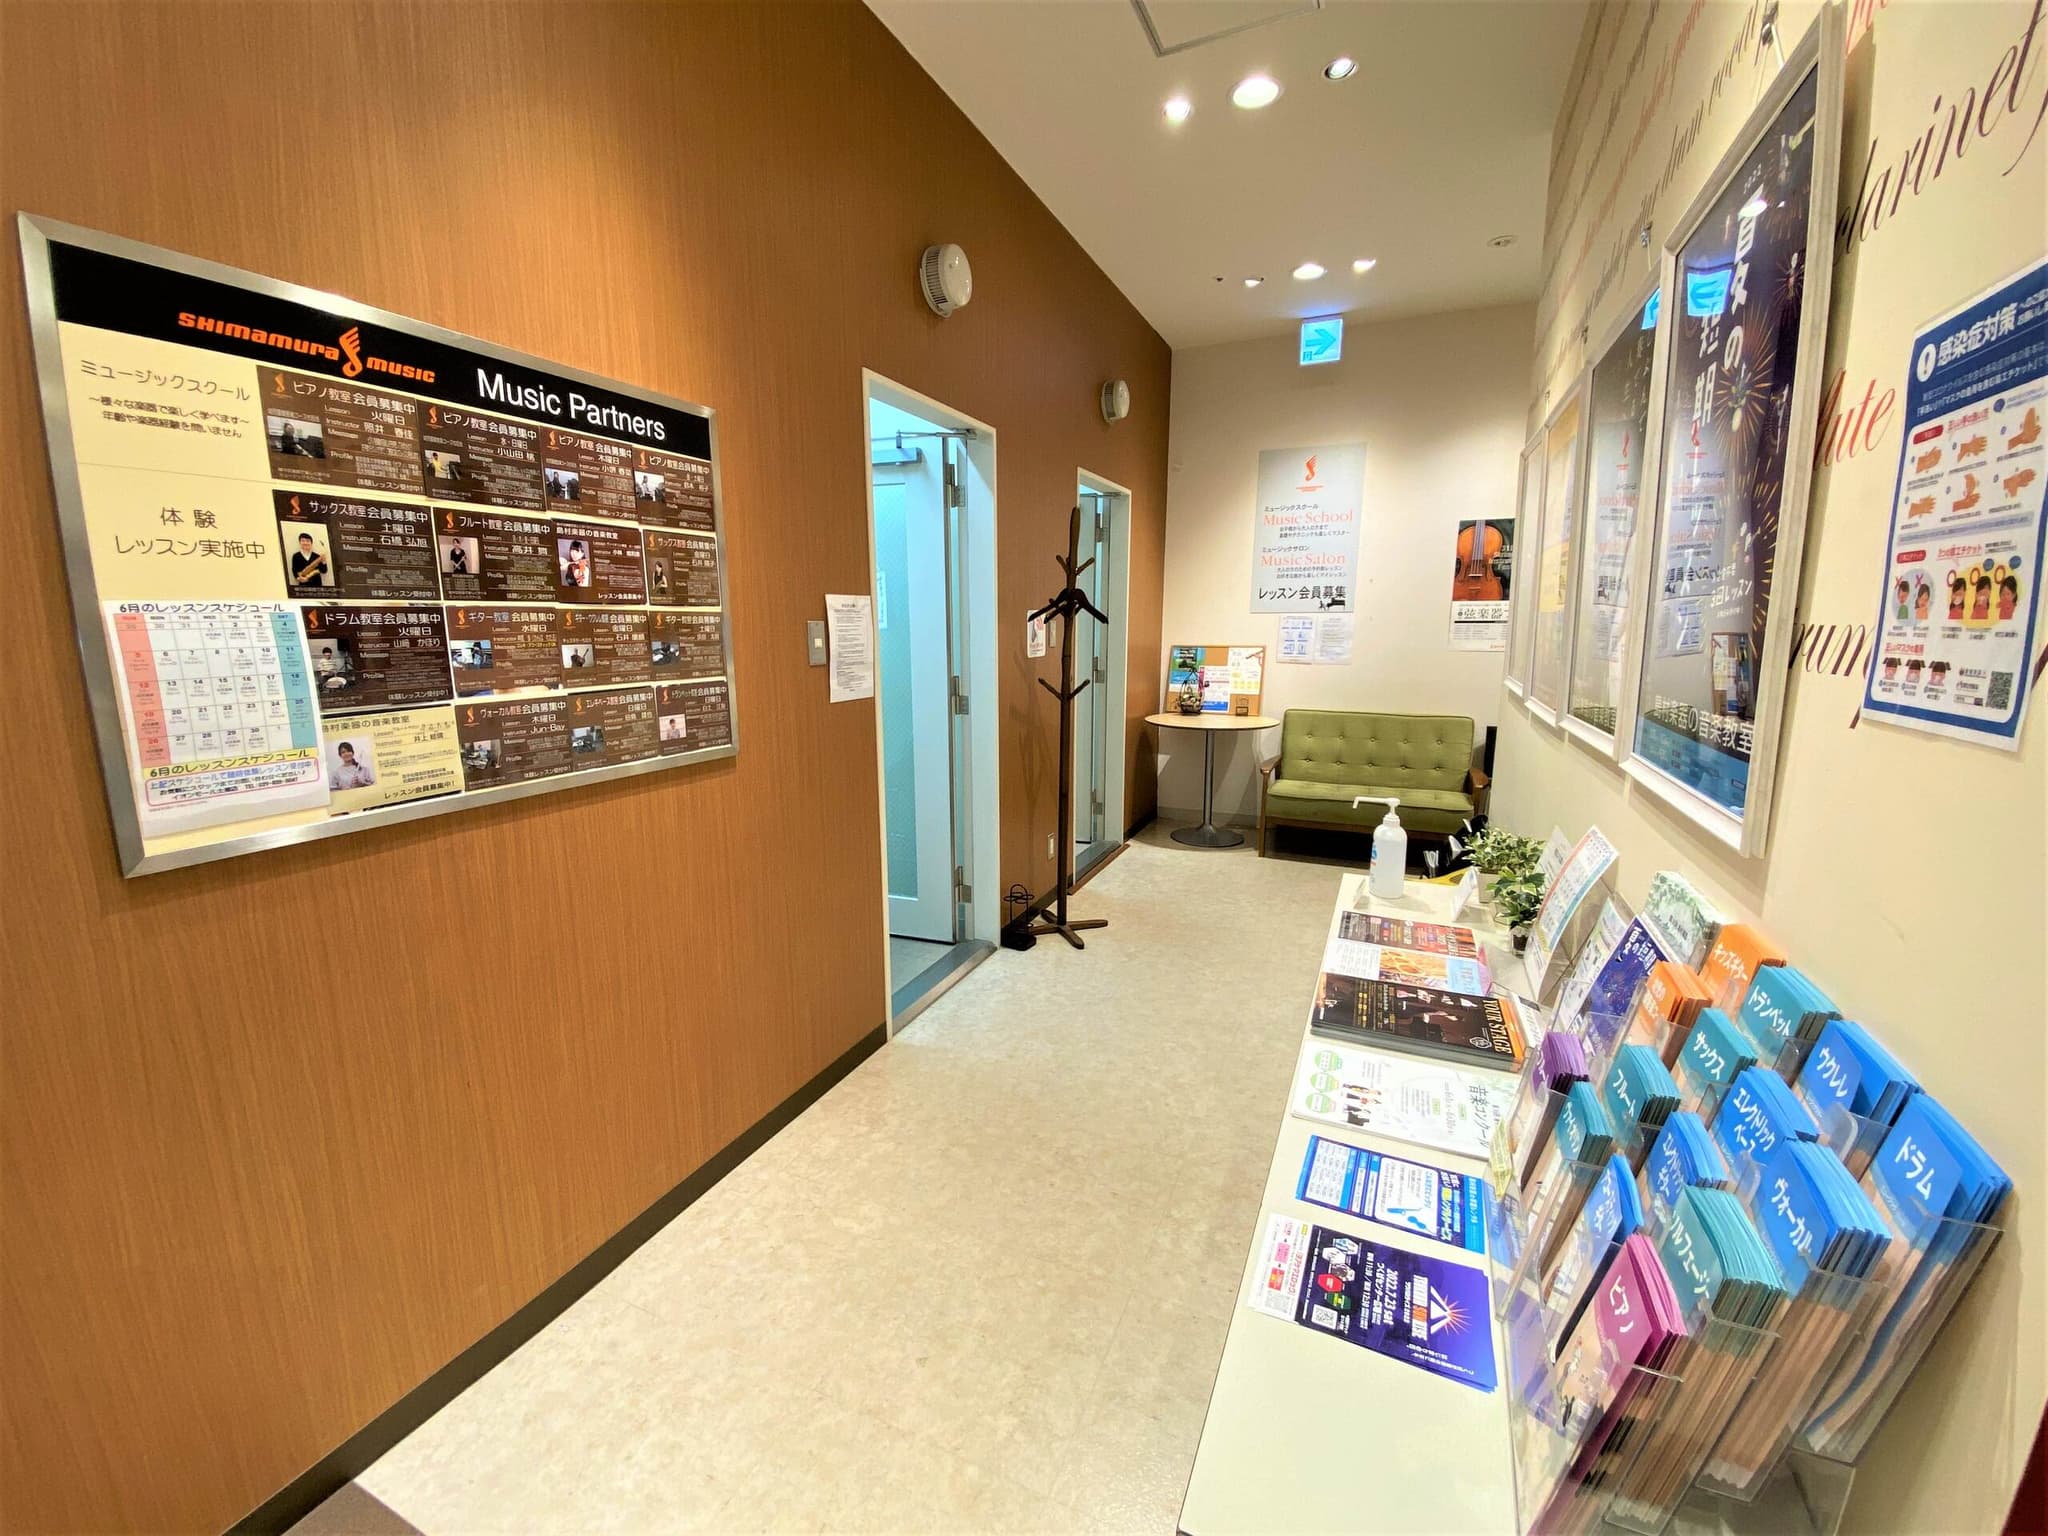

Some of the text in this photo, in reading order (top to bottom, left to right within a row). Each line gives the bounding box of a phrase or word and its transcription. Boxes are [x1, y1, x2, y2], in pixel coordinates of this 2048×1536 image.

[1937, 302, 2018, 366] 感染症対策
[80, 359, 250, 401] ミュージックスクール
[293, 381, 415, 414] ピアノ教室会員募集中
[477, 368, 666, 441] Music Partners
[371, 411, 405, 425] 火曜日
[443, 412, 537, 440] ピアノ教室会員募集中
[559, 435, 632, 459] ピアノ教室会員募集中
[309, 501, 428, 523] サックス教室会員募集中
[459, 516, 550, 534] フルート教室会員募集中
[1264, 509, 1353, 527] Music School
[381, 523, 415, 534] 土曜日
[115, 535, 265, 559] レッスン実施中
[1261, 552, 1346, 567] Music Salon
[1259, 585, 1346, 600] レッスン会員募集
[324, 613, 441, 625] ドラム教室会員募集中
[468, 612, 555, 622] ギター教室会員募集中
[399, 627, 432, 636] 火曜日
[150, 750, 310, 777] 6月のレッスンスケジュール
[1714, 943, 1748, 981] キッズギター
[1748, 985, 1793, 1036] トランペット
[1483, 999, 1512, 1055] YOUR STAGE
[1816, 1047, 1848, 1097] ウクレレ
[1612, 1068, 1636, 1117] フルート
[1733, 1087, 1776, 1151] エレクトリック
[1895, 1136, 1938, 1200] ドラム
[1771, 1177, 1813, 1254] ヴォーカル
[1609, 1275, 1634, 1333] ピアノ
